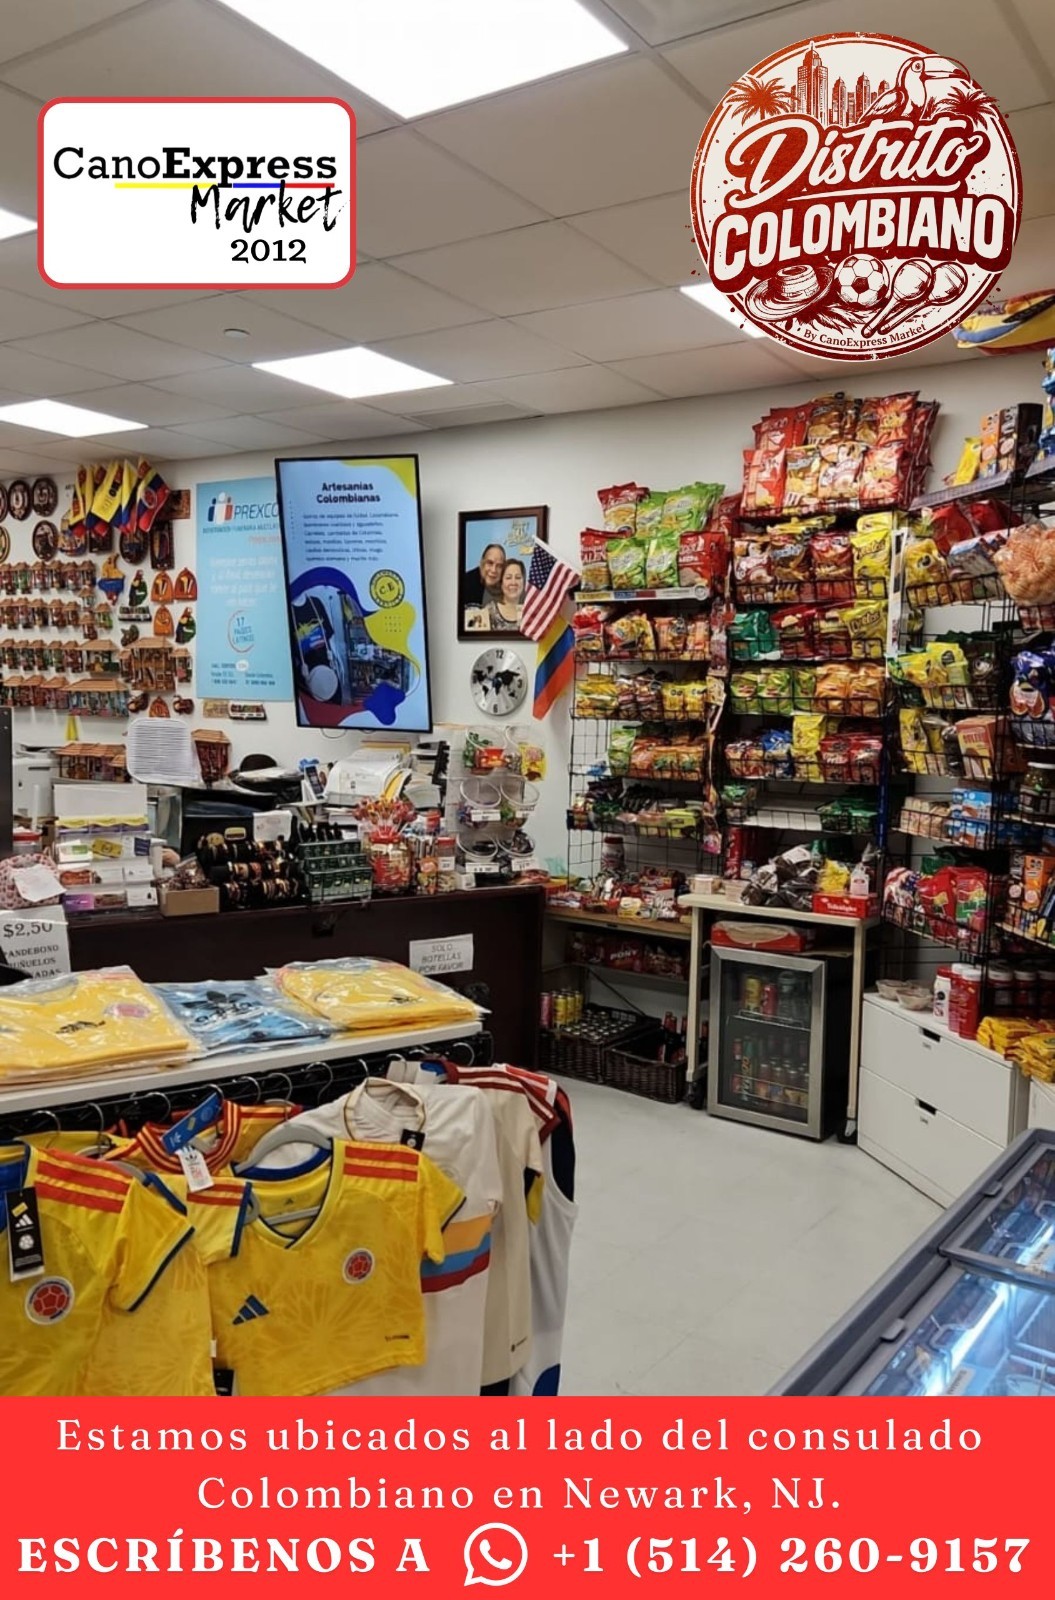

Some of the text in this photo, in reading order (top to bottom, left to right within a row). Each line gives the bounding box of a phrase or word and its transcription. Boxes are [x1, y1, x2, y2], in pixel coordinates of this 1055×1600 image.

[316, 493, 381, 504] Colombianas
[496, 649, 504, 659] 12
[517, 679, 523, 689] 3
[492, 704, 499, 714] 6
[421, 951, 462, 963] BOTELLAS
